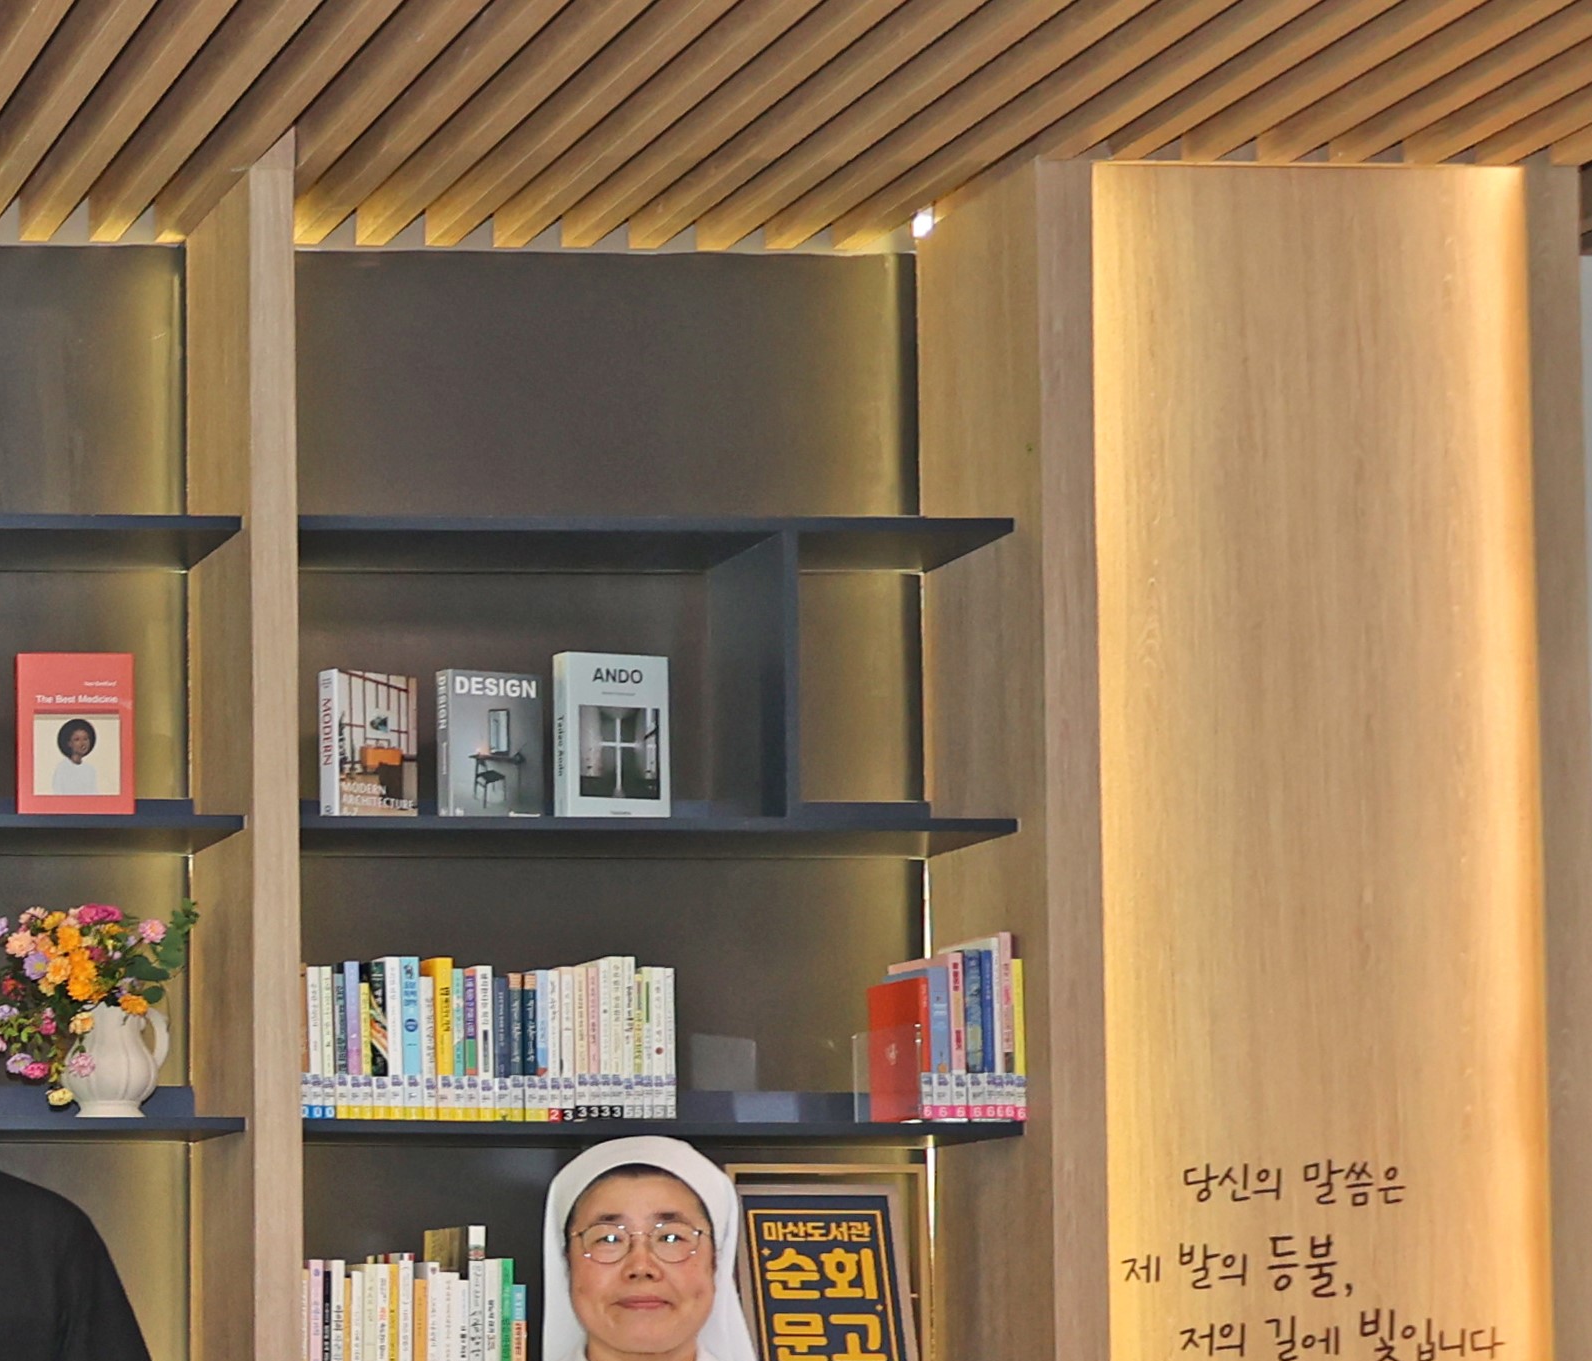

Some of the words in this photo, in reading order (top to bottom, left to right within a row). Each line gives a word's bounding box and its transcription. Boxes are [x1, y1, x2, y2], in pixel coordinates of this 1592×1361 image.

[592, 667, 644, 684] ANDO
[454, 676, 537, 698] DESIGN
[35, 694, 54, 704] The
[55, 694, 76, 704] Best
[78, 694, 119, 704] Medicine
[437, 676, 448, 730] DESIGN
[321, 698, 333, 766] MODERN
[341, 781, 388, 795] MODERN
[342, 794, 415, 811] ARCHITECTURE
[550, 1109, 559, 1119] 2
[564, 1109, 573, 1120] 3
[578, 1107, 587, 1118] 3
[590, 1107, 599, 1118] 3
[939, 1107, 948, 1118] 6
[973, 1107, 982, 1117] 6
[1006, 1107, 1015, 1117] 6
[1182, 1163, 1283, 1203] 당신의
[1302, 1159, 1407, 1207] 말씀은
[761, 1221, 872, 1243] 마산도서관
[764, 1246, 879, 1300] 순회
[1121, 1254, 1161, 1283] 제
[1178, 1243, 1248, 1290] 발의
[1266, 1234, 1354, 1298] 등불,
[1179, 1323, 1246, 1358] 저의
